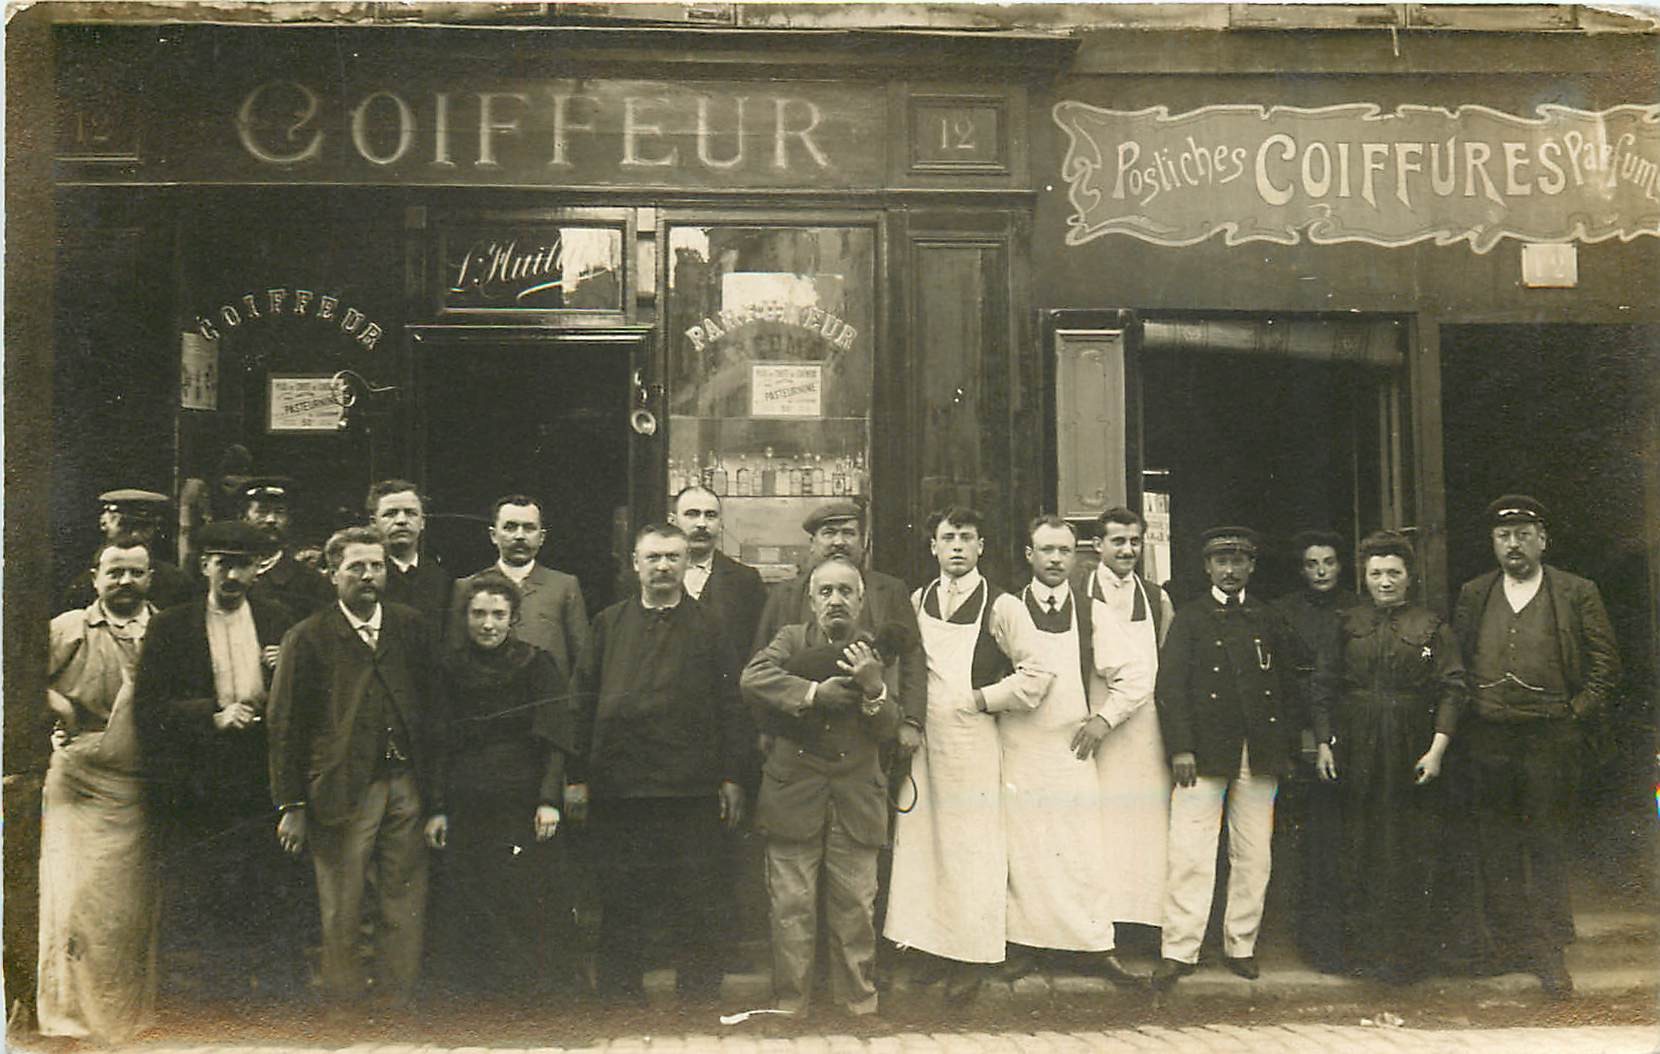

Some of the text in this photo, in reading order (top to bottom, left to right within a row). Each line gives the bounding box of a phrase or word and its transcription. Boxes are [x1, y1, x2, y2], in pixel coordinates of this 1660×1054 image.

[237, 80, 831, 169] COIFFEUR
[941, 118, 976, 149] 12
[1111, 136, 1246, 207] Postiches
[1254, 133, 1566, 209] COIFFURES
[196, 288, 383, 350] COIFFEUR
[684, 299, 858, 351] PAREUR
